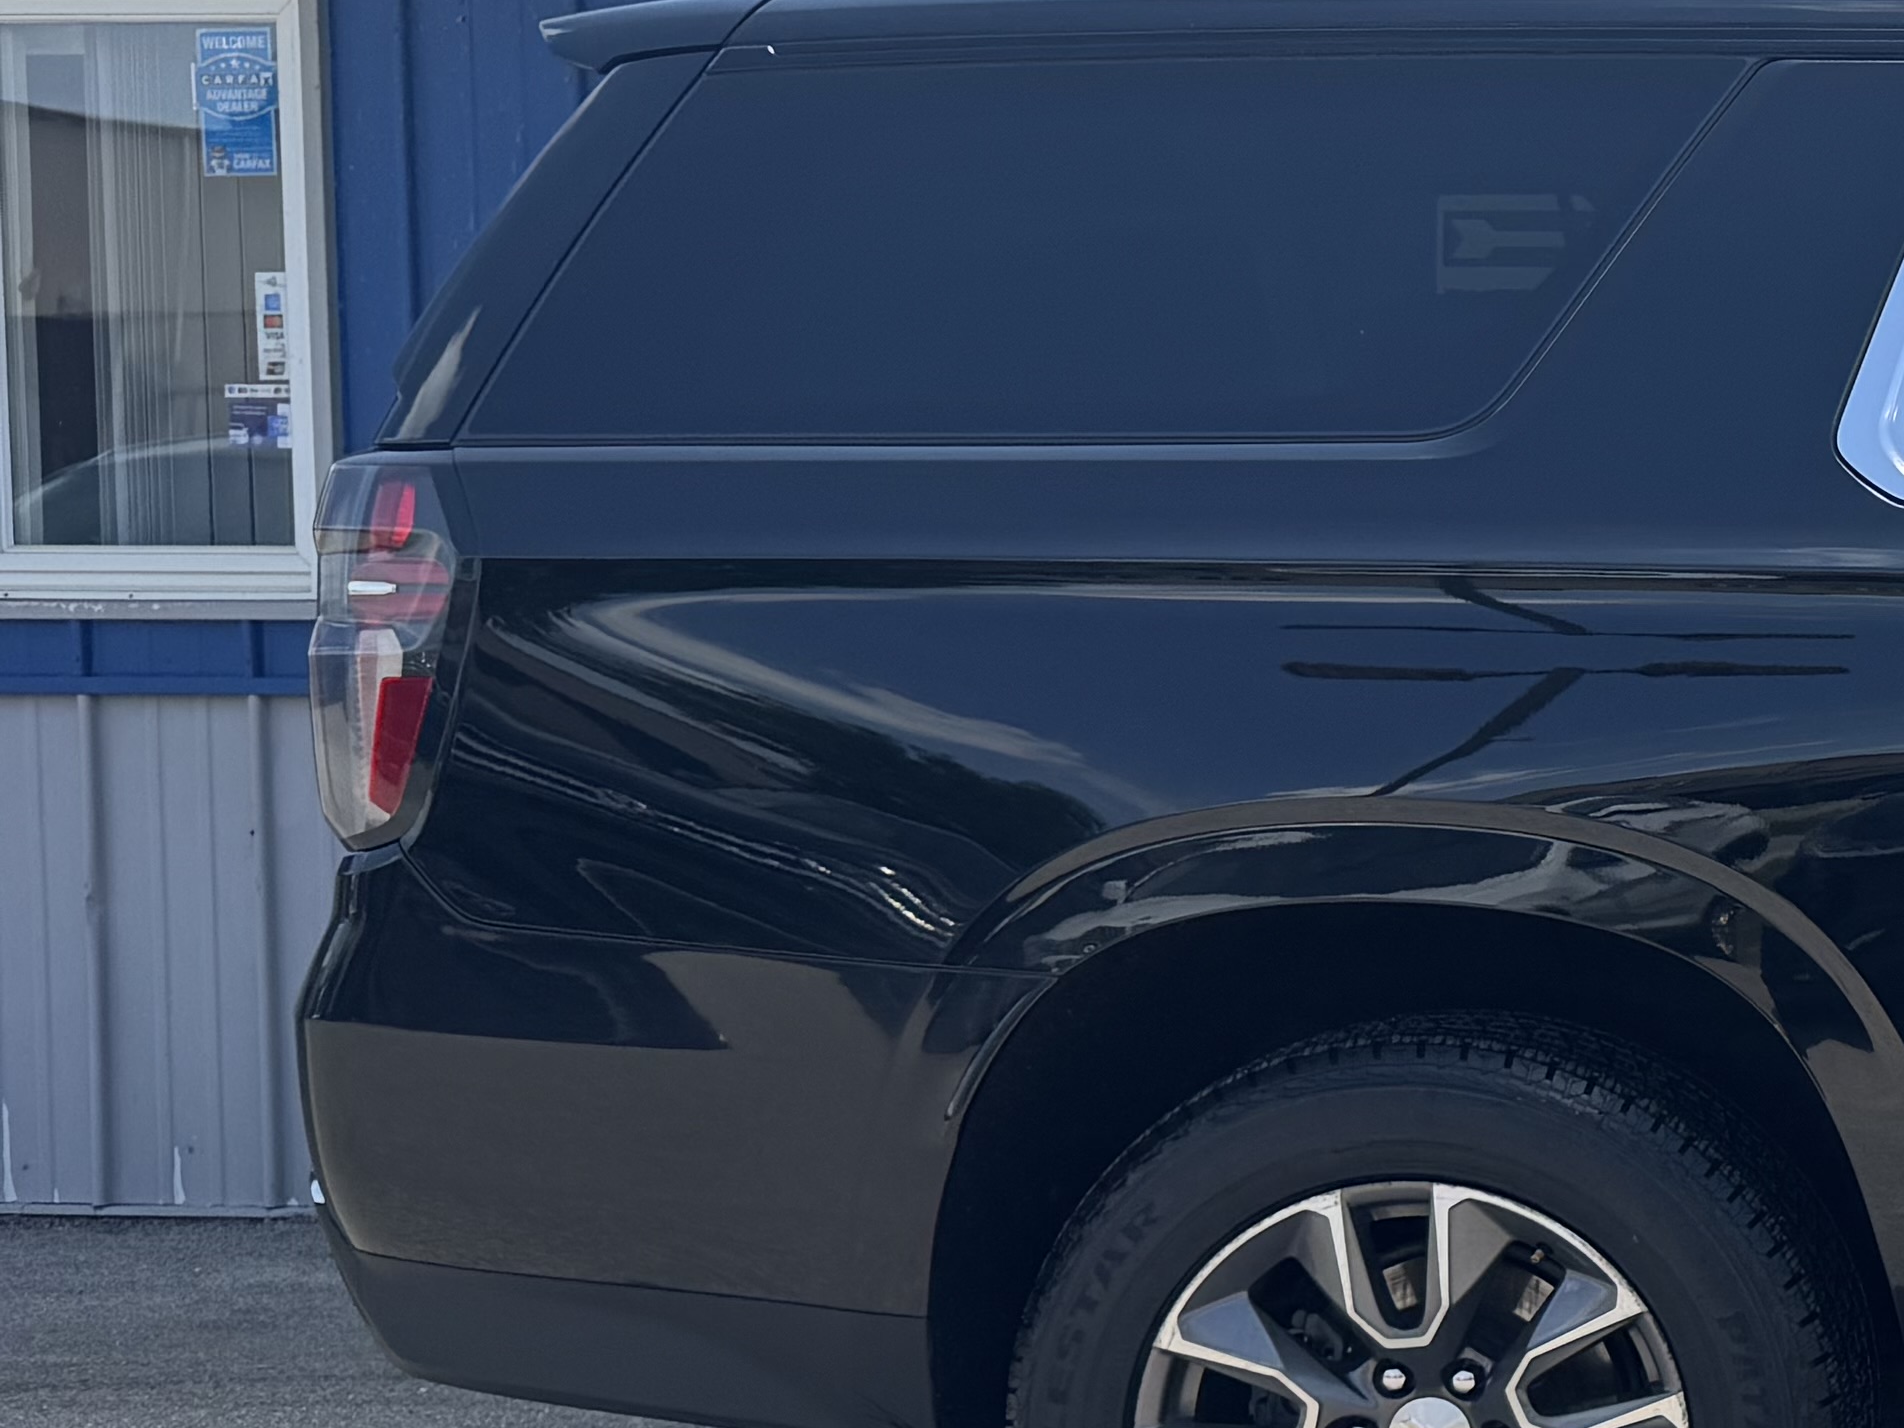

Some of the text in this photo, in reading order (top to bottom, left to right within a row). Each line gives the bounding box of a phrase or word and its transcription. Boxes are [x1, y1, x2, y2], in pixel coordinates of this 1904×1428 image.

[201, 35, 266, 50] WELCOME
[201, 72, 273, 86] CARFAX
[206, 88, 267, 101] ADVANTAGE
